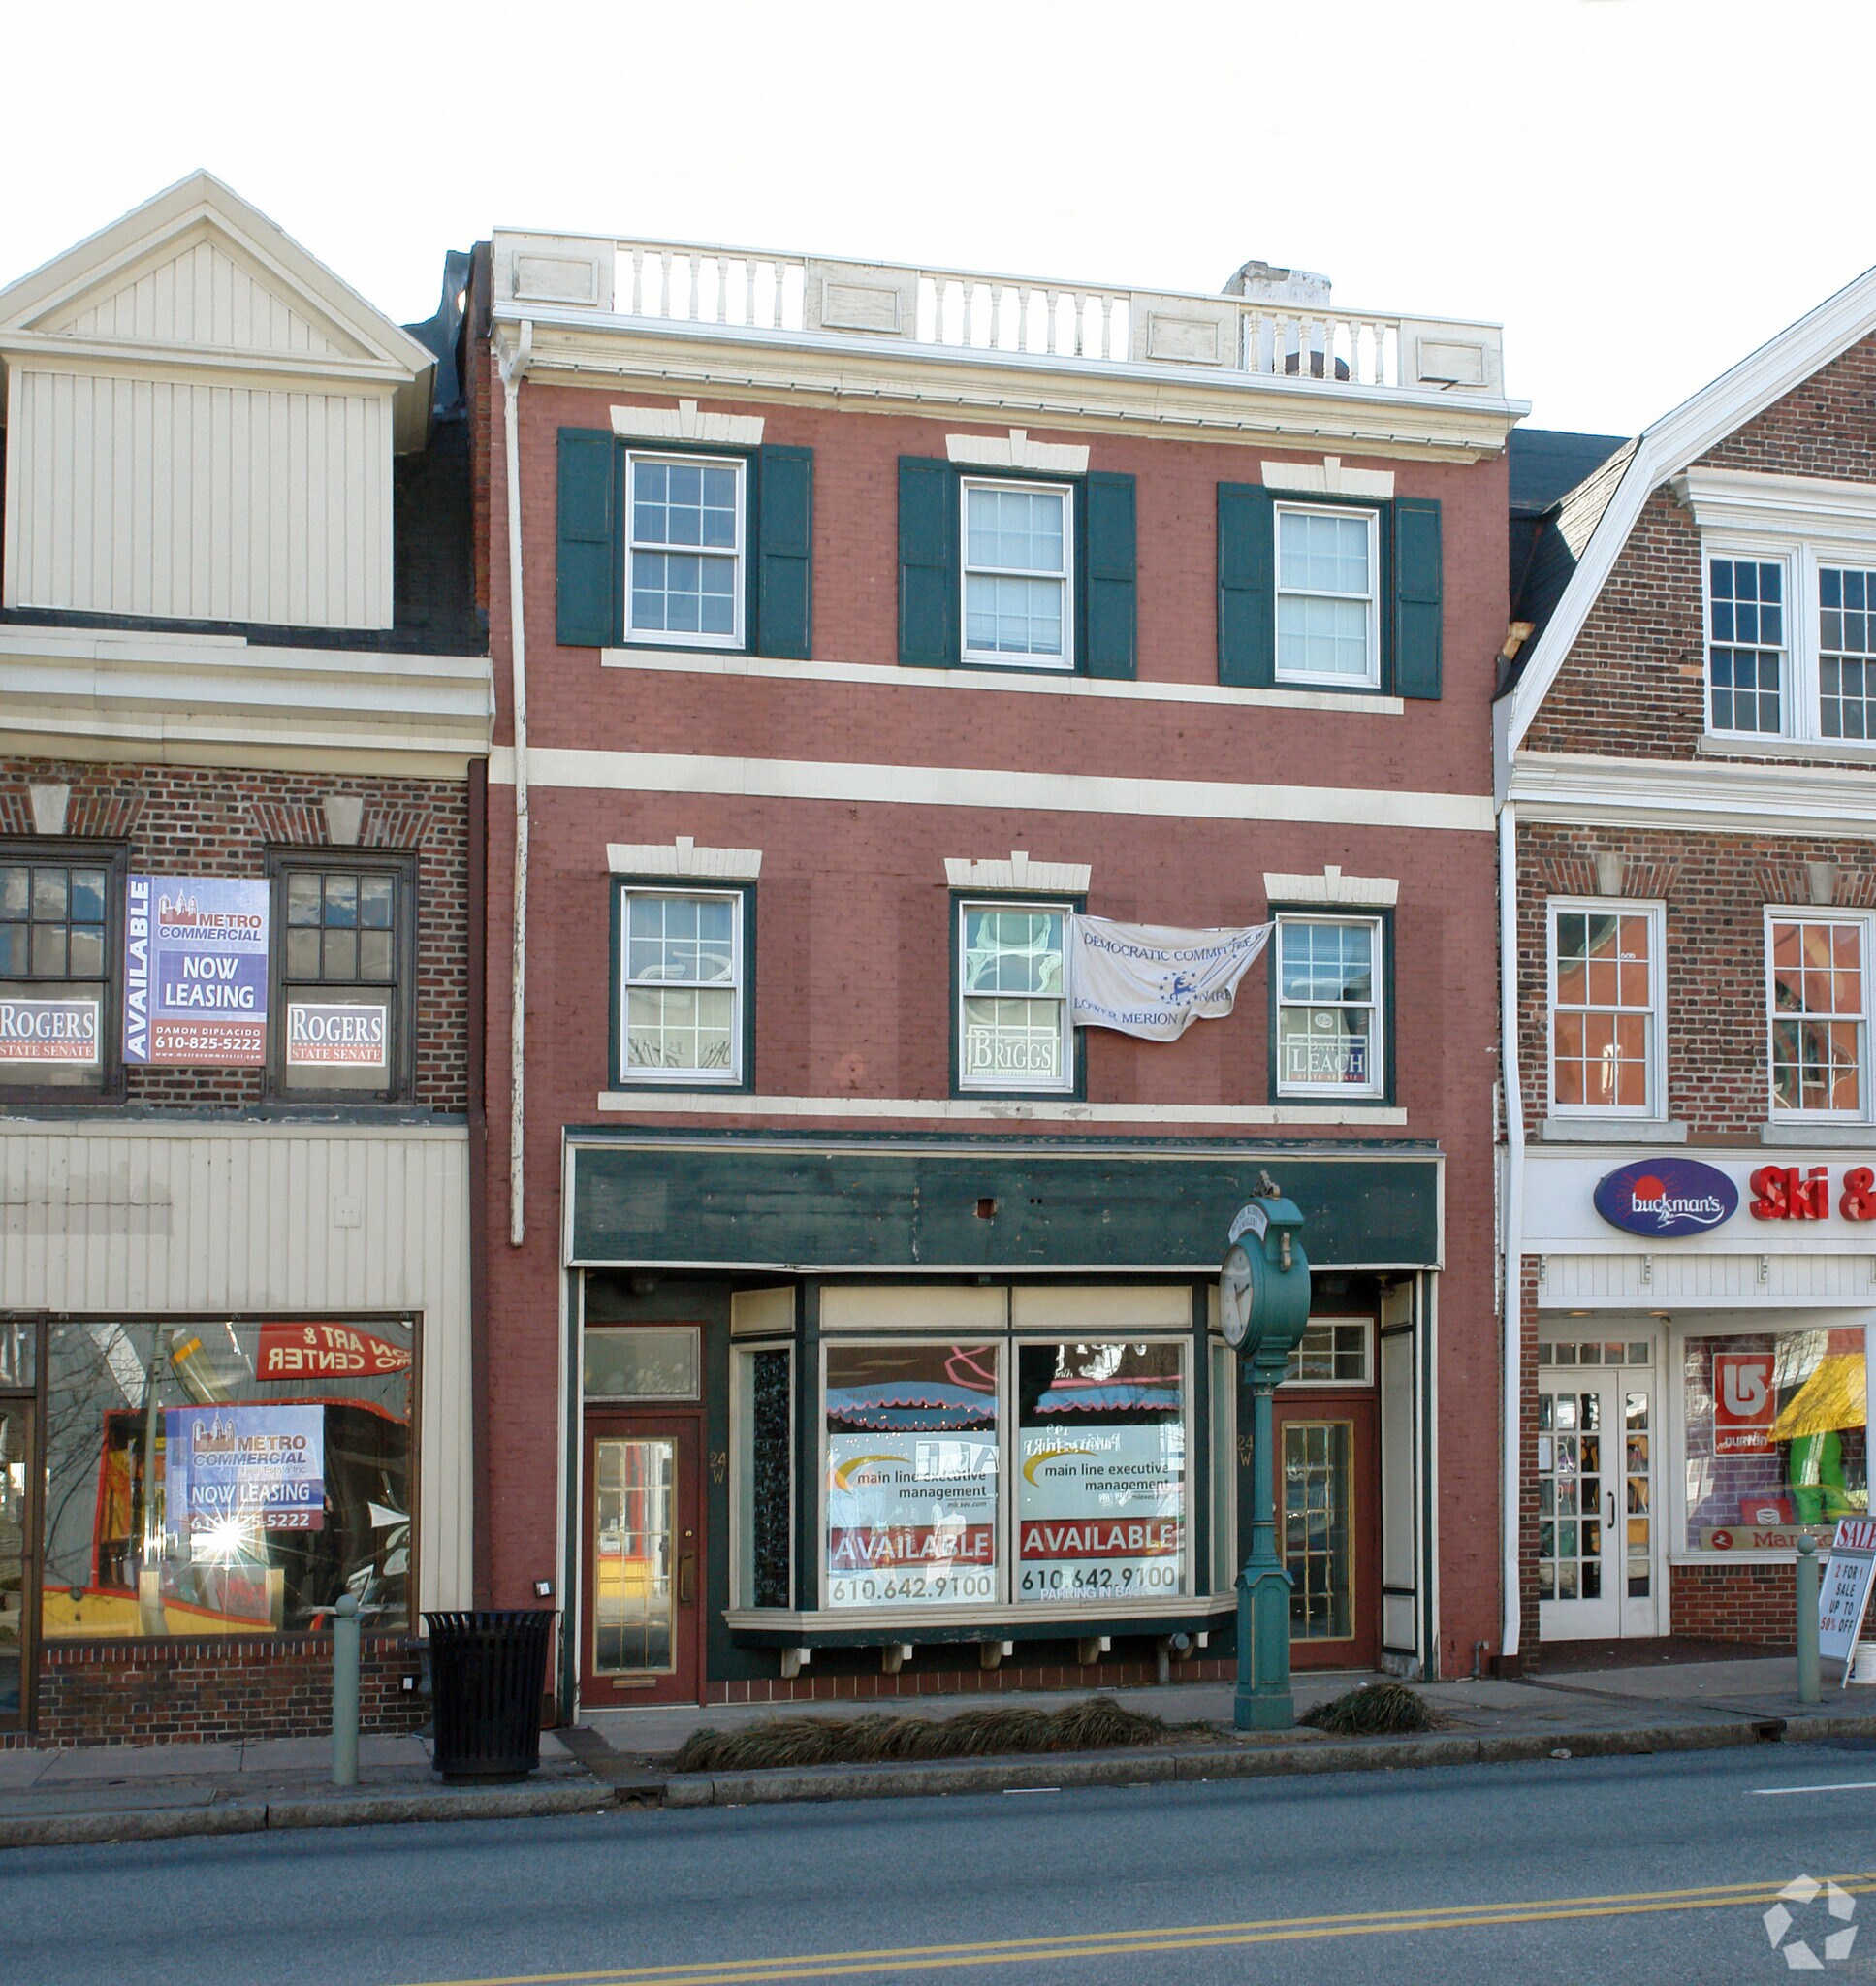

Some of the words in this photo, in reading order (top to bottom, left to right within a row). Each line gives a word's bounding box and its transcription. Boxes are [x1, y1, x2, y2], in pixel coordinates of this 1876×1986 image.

[199, 913, 262, 929] METRO
[159, 926, 262, 942] COMMERCIAL
[1084, 932, 1170, 961] DEMOCRATIC
[127, 881, 149, 1059] AVAILABLE
[183, 956, 239, 980] NOW
[165, 983, 254, 1009] LEASING
[0, 1005, 94, 1038] ROGERS
[292, 1009, 382, 1042] ROGERS
[1122, 1013, 1178, 1025] MERION
[156, 1026, 197, 1035] DAMON
[202, 1028, 261, 1037] DIPLACIDO
[0, 1045, 40, 1056] STATE
[43, 1045, 94, 1057] SENATE
[155, 1036, 261, 1051] 610-825-5222
[292, 1049, 331, 1059] STATE
[333, 1049, 381, 1061] SENATE
[1291, 1048, 1364, 1073] LEACH
[1750, 1166, 1828, 1221] Ski
[1839, 1167, 1876, 1222] &
[1632, 1193, 1723, 1216] buckman's
[238, 1435, 307, 1452] METRO
[1237, 1435, 1254, 1450] 24
[194, 1452, 307, 1467] COMMERCIAL
[710, 1452, 727, 1467] 24
[1240, 1453, 1251, 1466] W
[714, 1469, 724, 1484] W
[857, 1472, 890, 1484] main
[895, 1469, 918, 1483] line
[1045, 1464, 1076, 1476] main
[1081, 1463, 1104, 1475] line
[1108, 1461, 1169, 1474] executive
[1085, 1478, 1170, 1491] management
[192, 1485, 236, 1504] NOW
[239, 1483, 310, 1502] LEASING
[899, 1486, 987, 1500] management
[1024, 1524, 1173, 1552] AVAILABLE
[1837, 1520, 1876, 1550] SALE
[835, 1533, 988, 1561] AVAILABLE
[1022, 1566, 1175, 1590] 610.642.9100
[1834, 1564, 1841, 1578] 2
[1843, 1565, 1858, 1580] FOR
[1859, 1567, 1863, 1580] 1
[833, 1575, 991, 1601] 610.642.9100
[1098, 1586, 1111, 1597] IN
[1835, 1583, 1856, 1598] SALE
[1829, 1599, 1840, 1614] UP
[1843, 1601, 1854, 1616] TO
[1821, 1617, 1836, 1631] 50%
[1838, 1619, 1854, 1633] OFF
